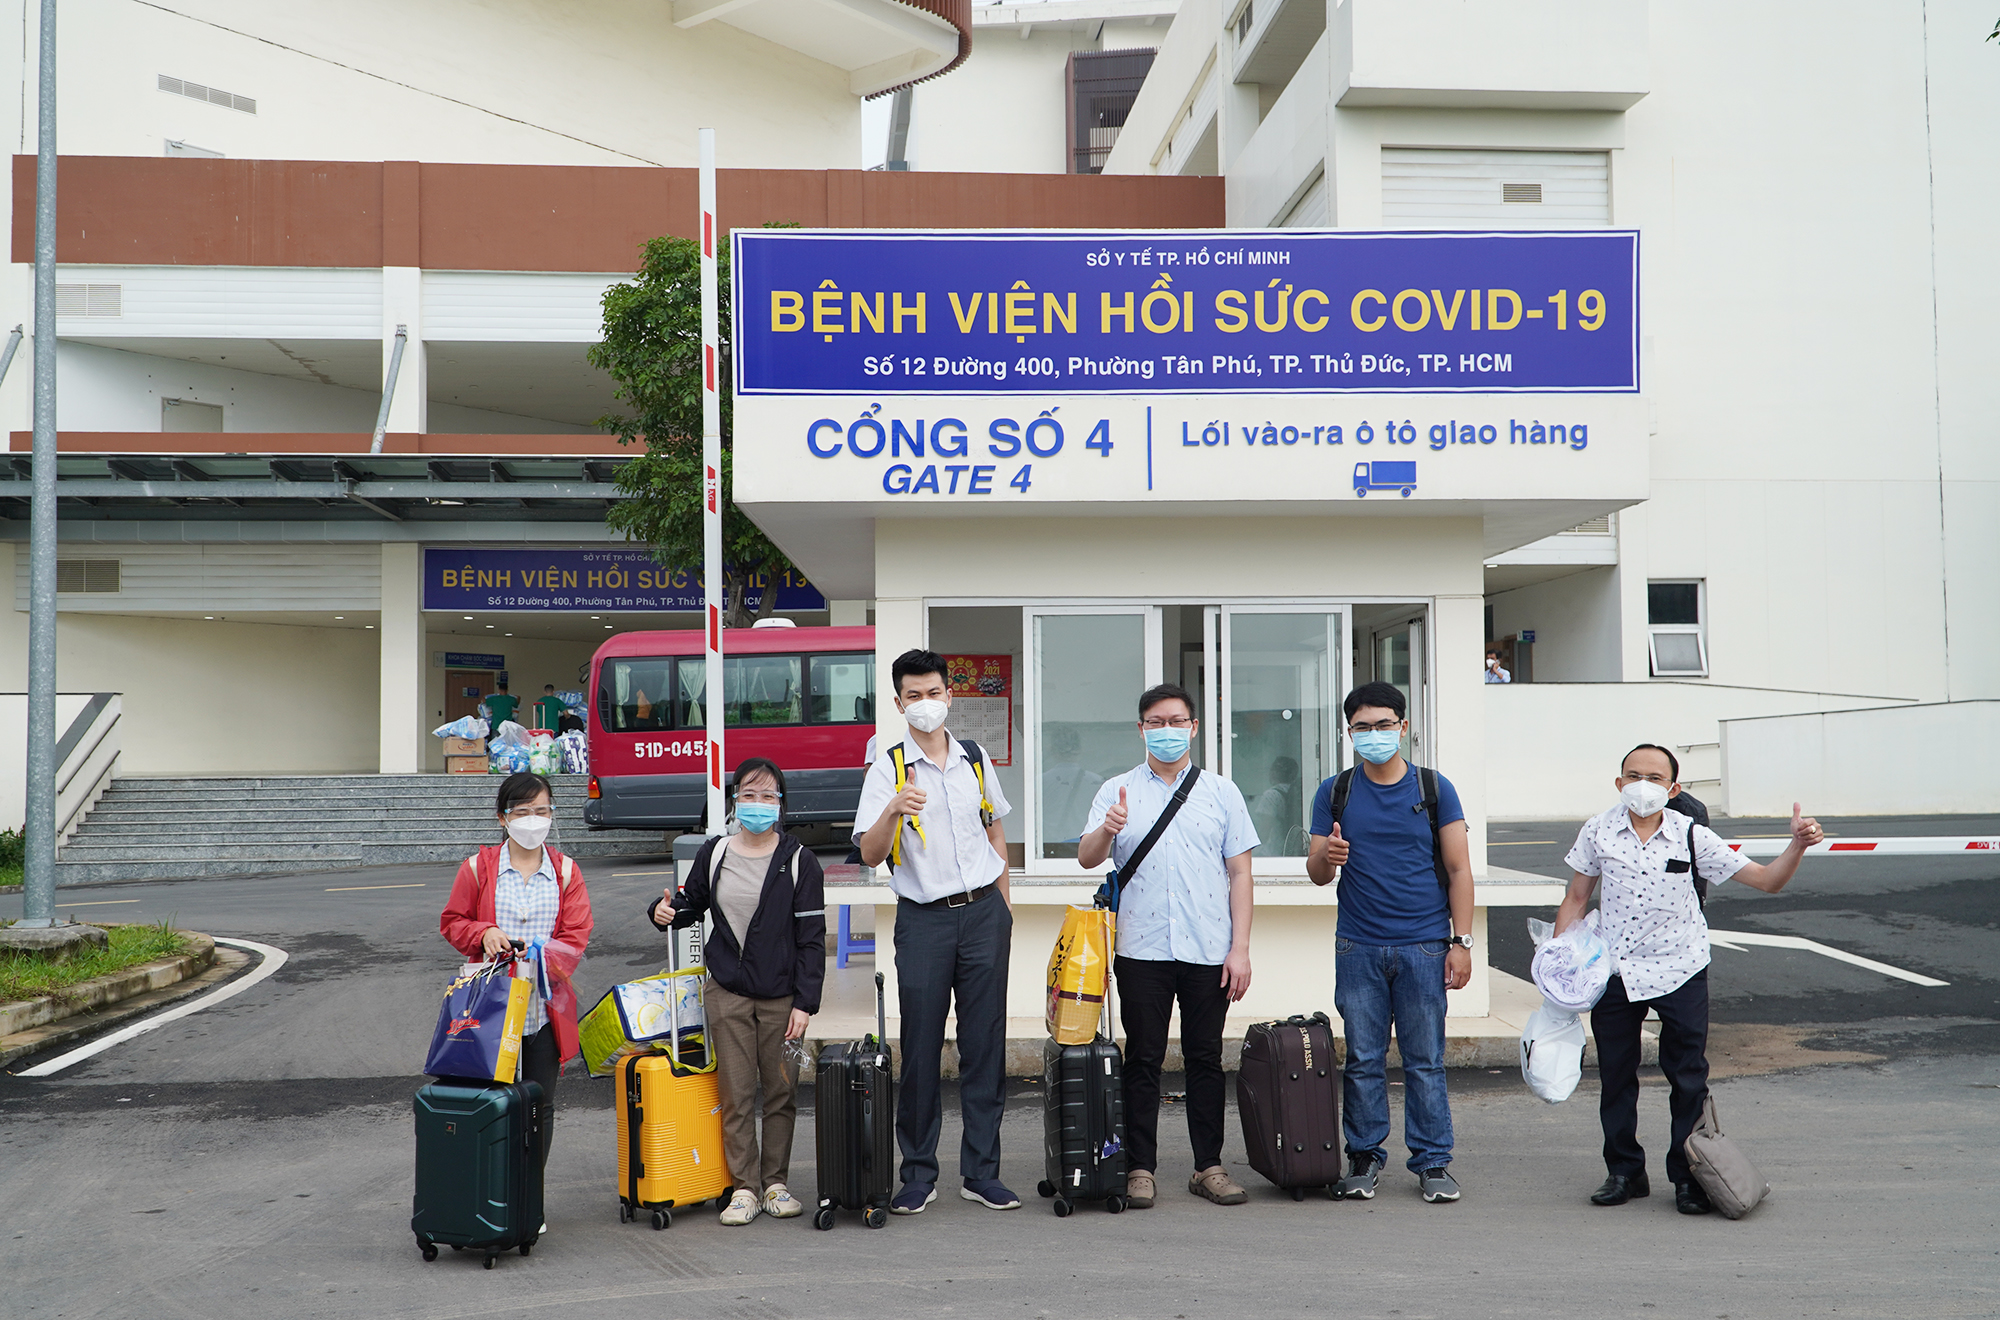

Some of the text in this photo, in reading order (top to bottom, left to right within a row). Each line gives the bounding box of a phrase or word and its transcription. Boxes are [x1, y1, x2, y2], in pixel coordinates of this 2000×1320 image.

[1086, 246, 1290, 266] SỞ Y TẾ TP. HỒ CHÍ MINH
[770, 272, 1606, 344] BỆNH VIỆN HỒI SỨC COVID-19
[863, 353, 1512, 381] Số 12 Đường 400, Phường Tân Phú, TP. Thủ Đức, TP. HCM
[806, 402, 1114, 459] CỔNG SỐ 4
[1182, 419, 1588, 450] Lối vào-ra ô tô giao hàng
[882, 464, 1032, 494] GATE 4
[442, 564, 511, 592] BỆNH
[521, 565, 578, 592] VIỆN
[587, 563, 629, 589] HỒI
[638, 566, 688, 589] SỨC
[488, 596, 502, 606] Số
[504, 597, 516, 606] 12
[517, 596, 550, 608] Đường
[552, 597, 572, 607] 400,
[575, 596, 612, 608] Phường
[615, 597, 633, 606] Tân
[636, 596, 658, 607] Phú,
[660, 597, 675, 606] TP.
[677, 596, 696, 606] Thủ
[984, 666, 1000, 675] 2021
[1076, 976, 1086, 1006] KOREAN
[1302, 1033, 1311, 1049] POLO
